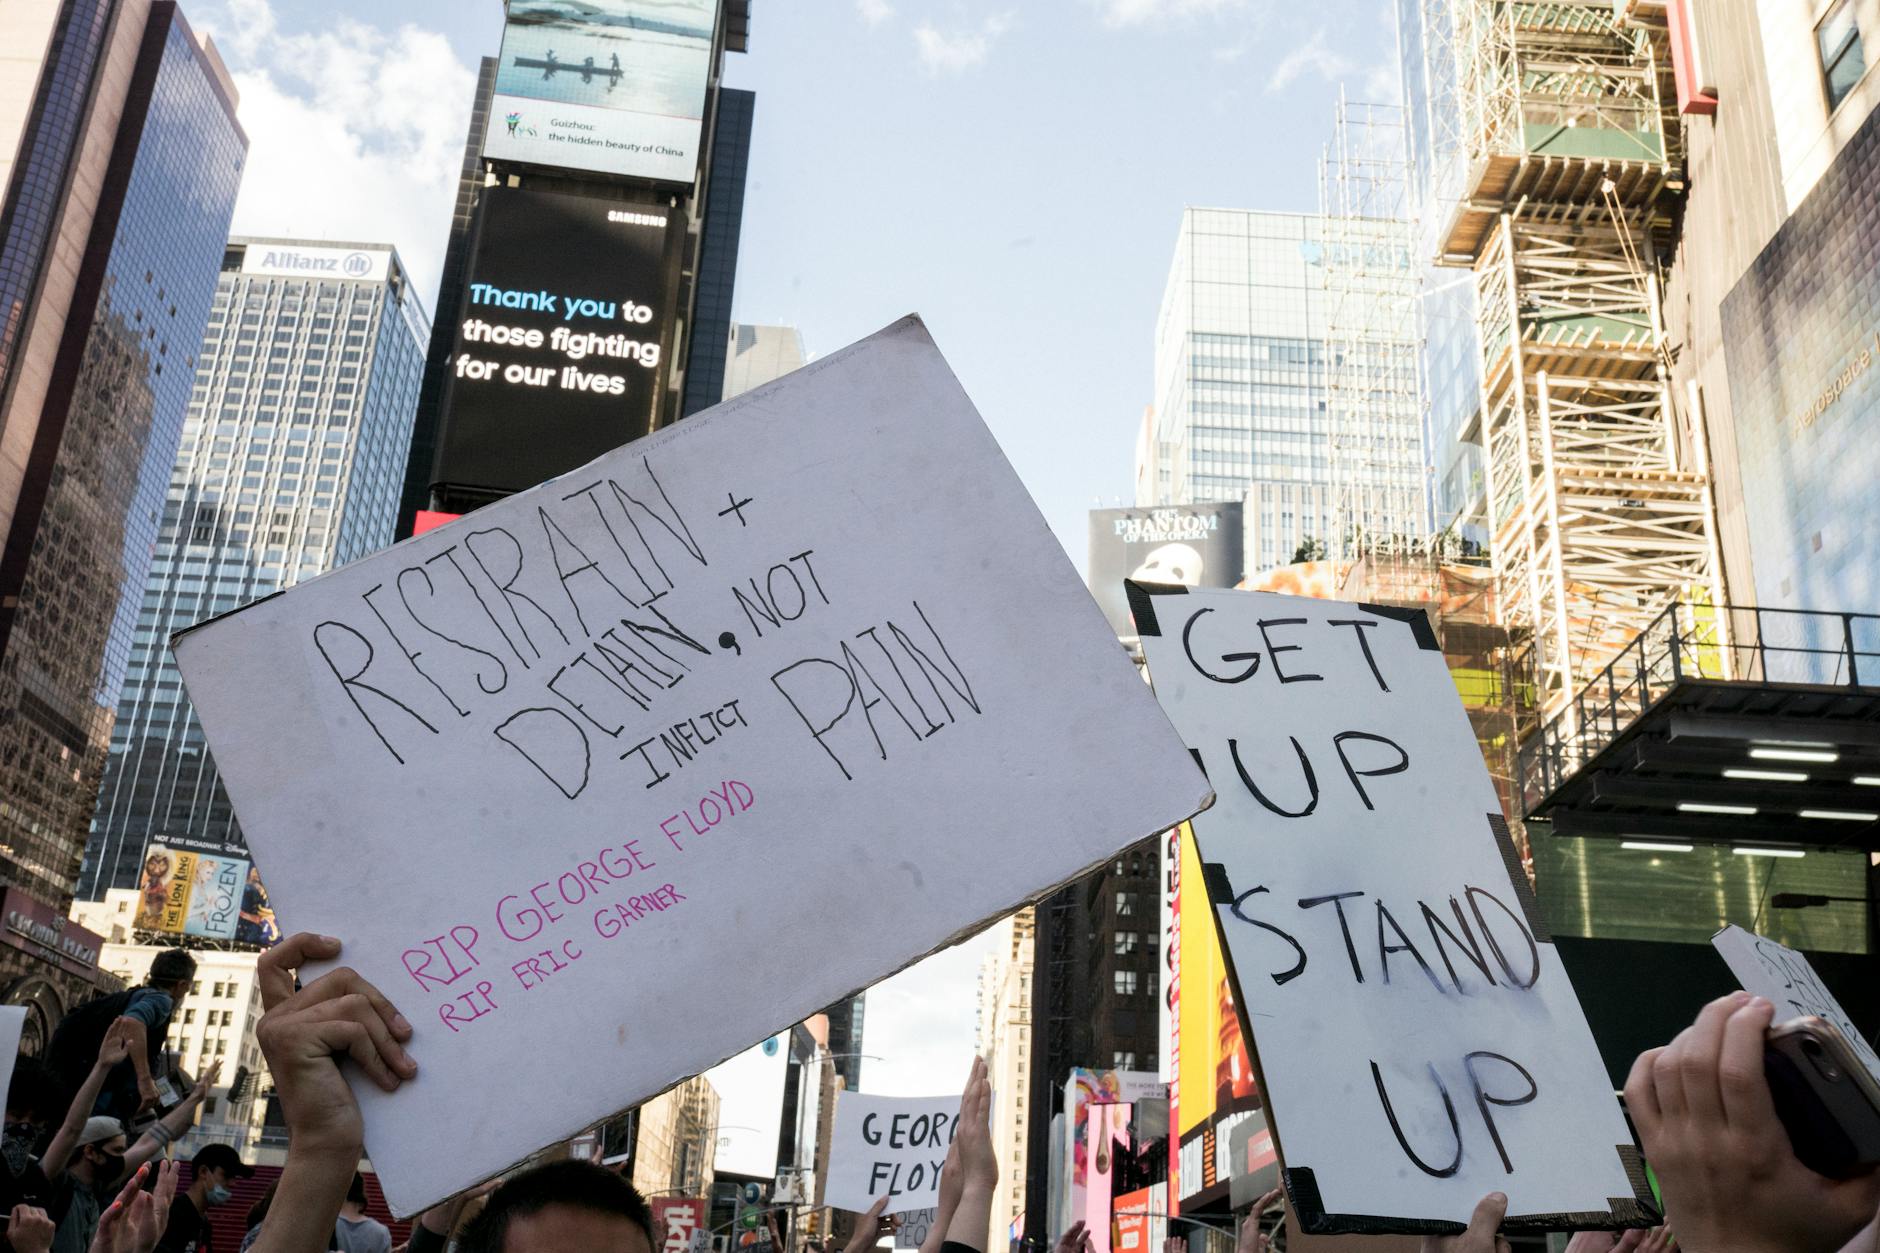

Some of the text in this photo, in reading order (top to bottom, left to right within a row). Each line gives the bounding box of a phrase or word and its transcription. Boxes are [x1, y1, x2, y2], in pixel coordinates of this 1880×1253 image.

[548, 132, 684, 158] the hidden beauty of China
[608, 210, 667, 228] SAMSUNG
[262, 251, 338, 272] Allianz
[470, 284, 653, 324] Thank you to
[462, 318, 544, 348] those
[550, 328, 661, 368] fighting
[456, 353, 626, 395] for our lives
[1792, 349, 1870, 439] Aerospace
[1114, 516, 1218, 535] PHANTOM
[1123, 530, 1208, 544] OF THE OPERA
[732, 550, 830, 637] NOT
[1182, 607, 1391, 692] GET
[620, 600, 982, 788] INFLICT PAIN
[1227, 730, 1409, 818] UP
[154, 834, 169, 843] NOT
[170, 836, 185, 845] JUST
[225, 843, 248, 857] Disney
[204, 861, 240, 934] FROZEN
[401, 780, 754, 992] RIP GEORGE FLOYD
[166, 910, 179, 928] THE
[1230, 884, 1540, 996] STAND
[438, 883, 687, 1032] RIP ERIC GARNER
[862, 1112, 960, 1149] GEOR
[1369, 1050, 1538, 1178] UP
[868, 1159, 945, 1196] FLOY
